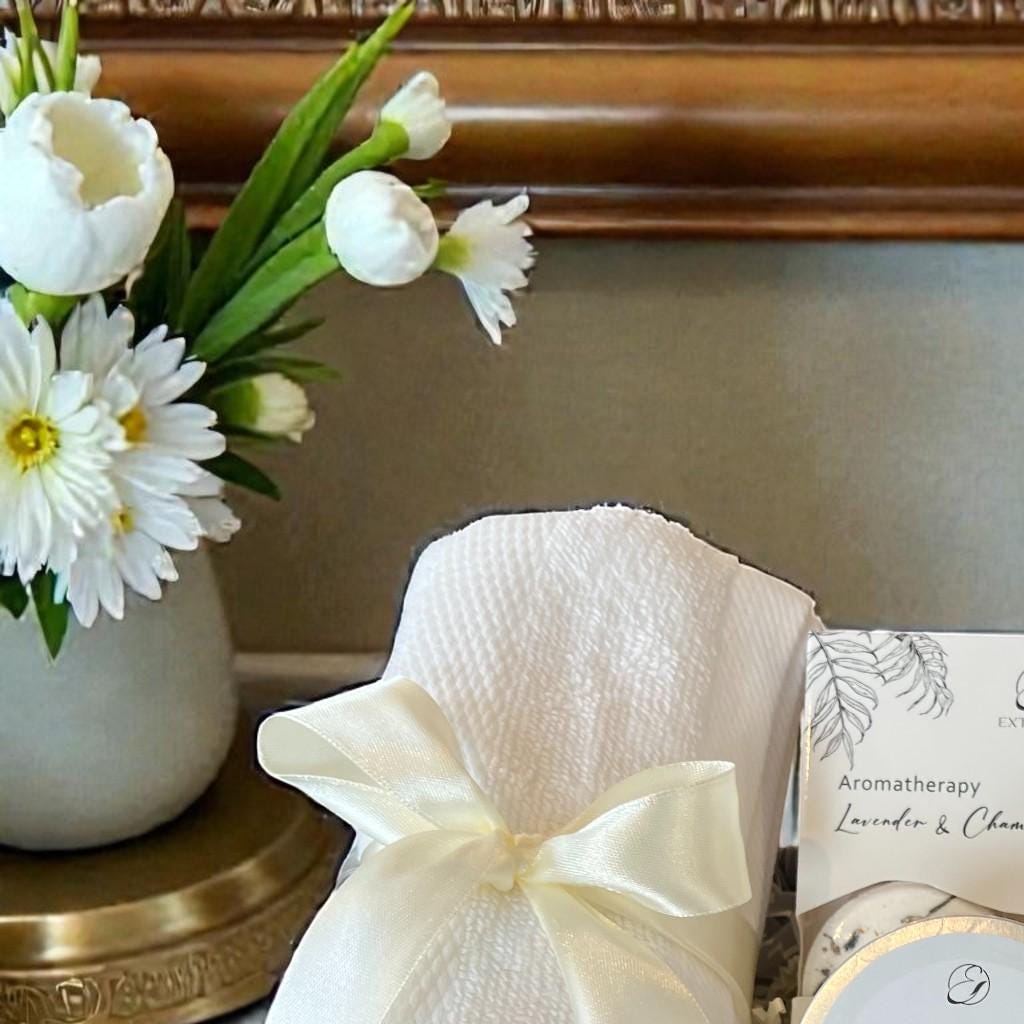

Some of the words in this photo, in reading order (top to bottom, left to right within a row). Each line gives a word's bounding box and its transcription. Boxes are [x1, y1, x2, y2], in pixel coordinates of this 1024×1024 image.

[838, 775, 981, 798] Aromatherapy
[834, 802, 927, 835] Lavender
[936, 814, 950, 836] &
